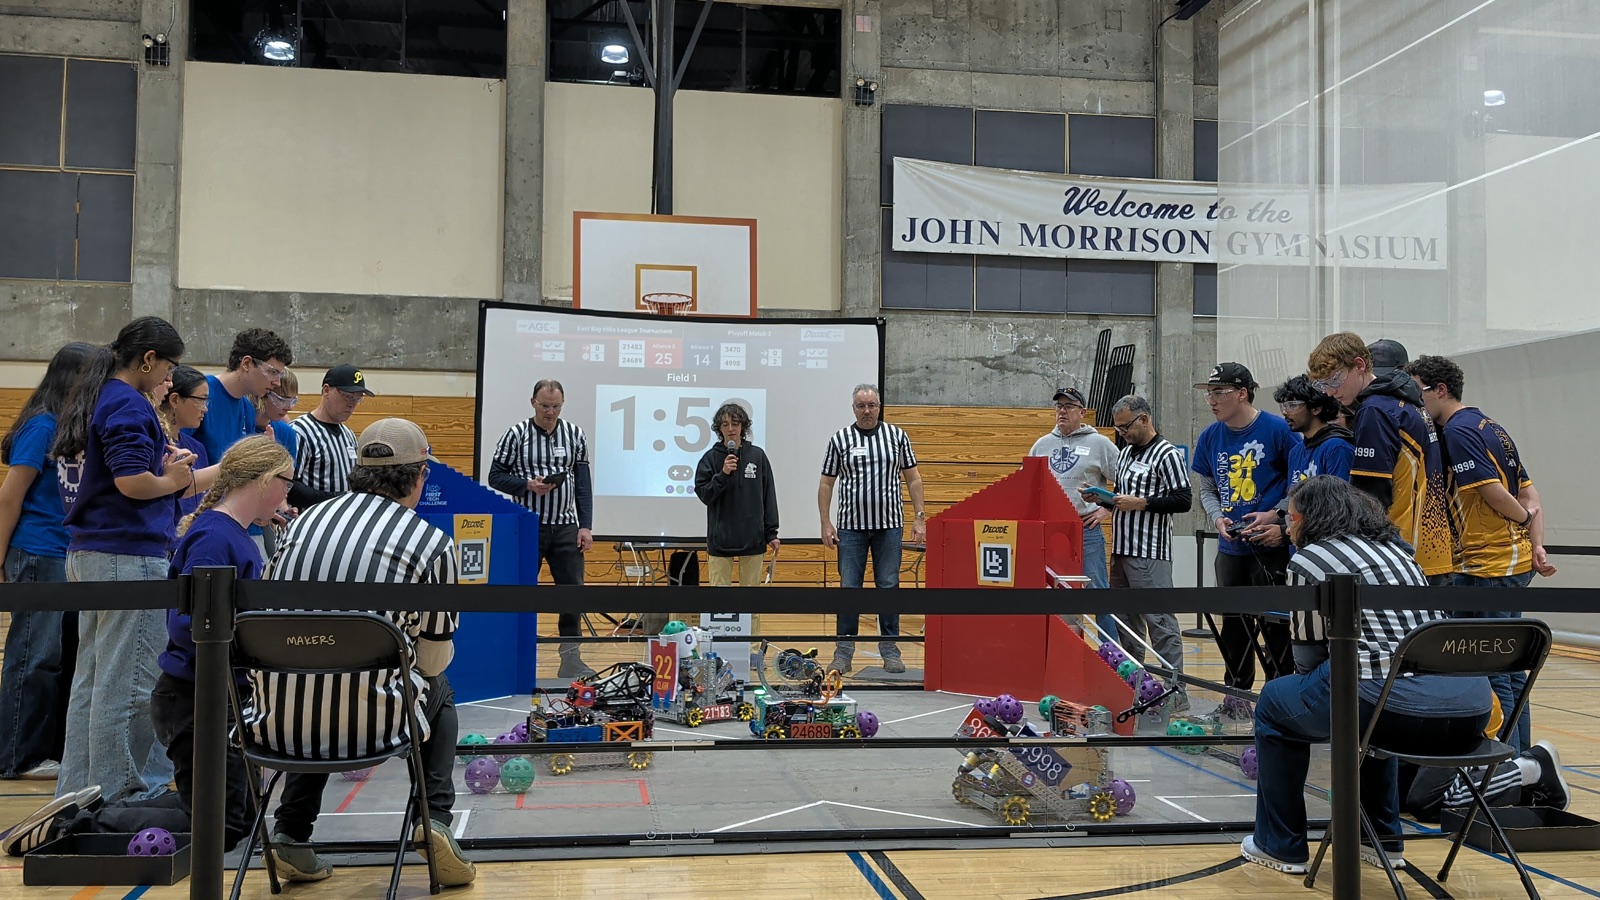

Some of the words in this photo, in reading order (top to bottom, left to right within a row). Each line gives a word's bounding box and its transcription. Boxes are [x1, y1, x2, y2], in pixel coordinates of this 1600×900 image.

[1063, 186, 1195, 220] Welcome
[1206, 197, 1238, 221] to
[1246, 198, 1293, 223] the
[901, 217, 1002, 246] JOHN
[1018, 222, 1212, 255] MORRISON
[1226, 231, 1440, 262] GYMNASIUM
[617, 327, 638, 335] League
[655, 353, 672, 365] 25
[694, 354, 711, 366] 14
[667, 373, 689, 382] Field
[692, 374, 697, 382] 1
[1228, 450, 1257, 480] 34
[1452, 460, 1476, 474] 4998
[461, 519, 486, 529] DECODE
[982, 524, 1009, 534] DECODE
[286, 634, 336, 646] MAKERS
[1441, 638, 1516, 655] MAKERS
[655, 654, 673, 680] 22
[704, 705, 731, 719] 21483
[792, 725, 831, 738] 24689
